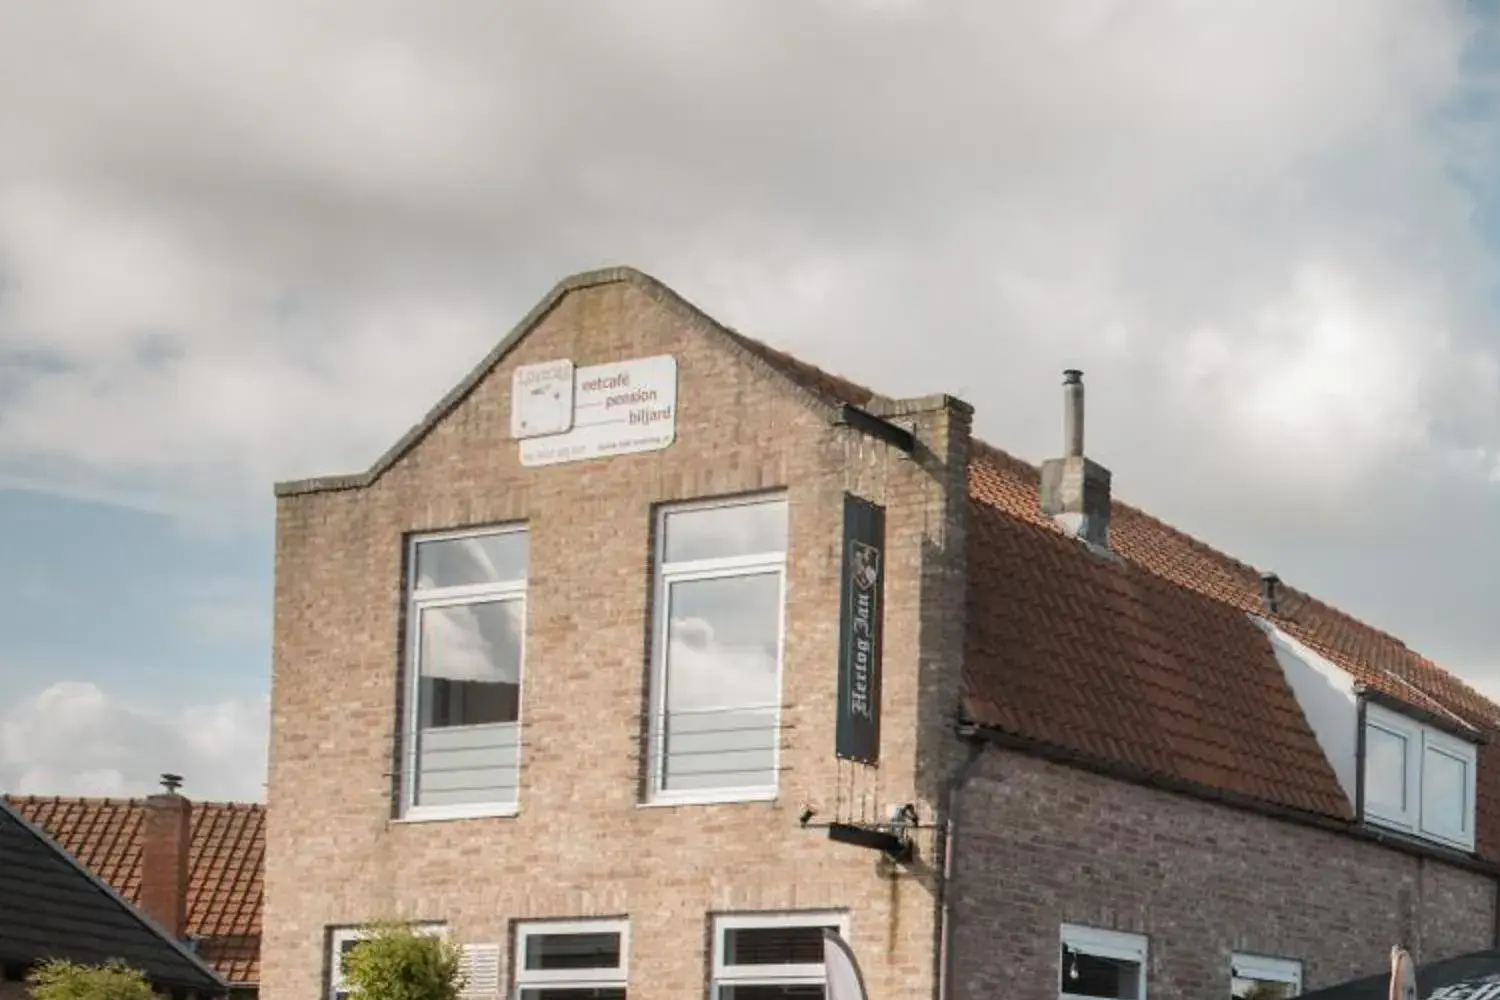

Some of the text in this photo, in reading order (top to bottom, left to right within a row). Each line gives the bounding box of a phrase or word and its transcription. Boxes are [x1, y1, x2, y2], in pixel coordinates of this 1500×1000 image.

[605, 387, 657, 411] pension
[628, 405, 672, 425] biljard
[851, 593, 870, 720] Hertog Jan
